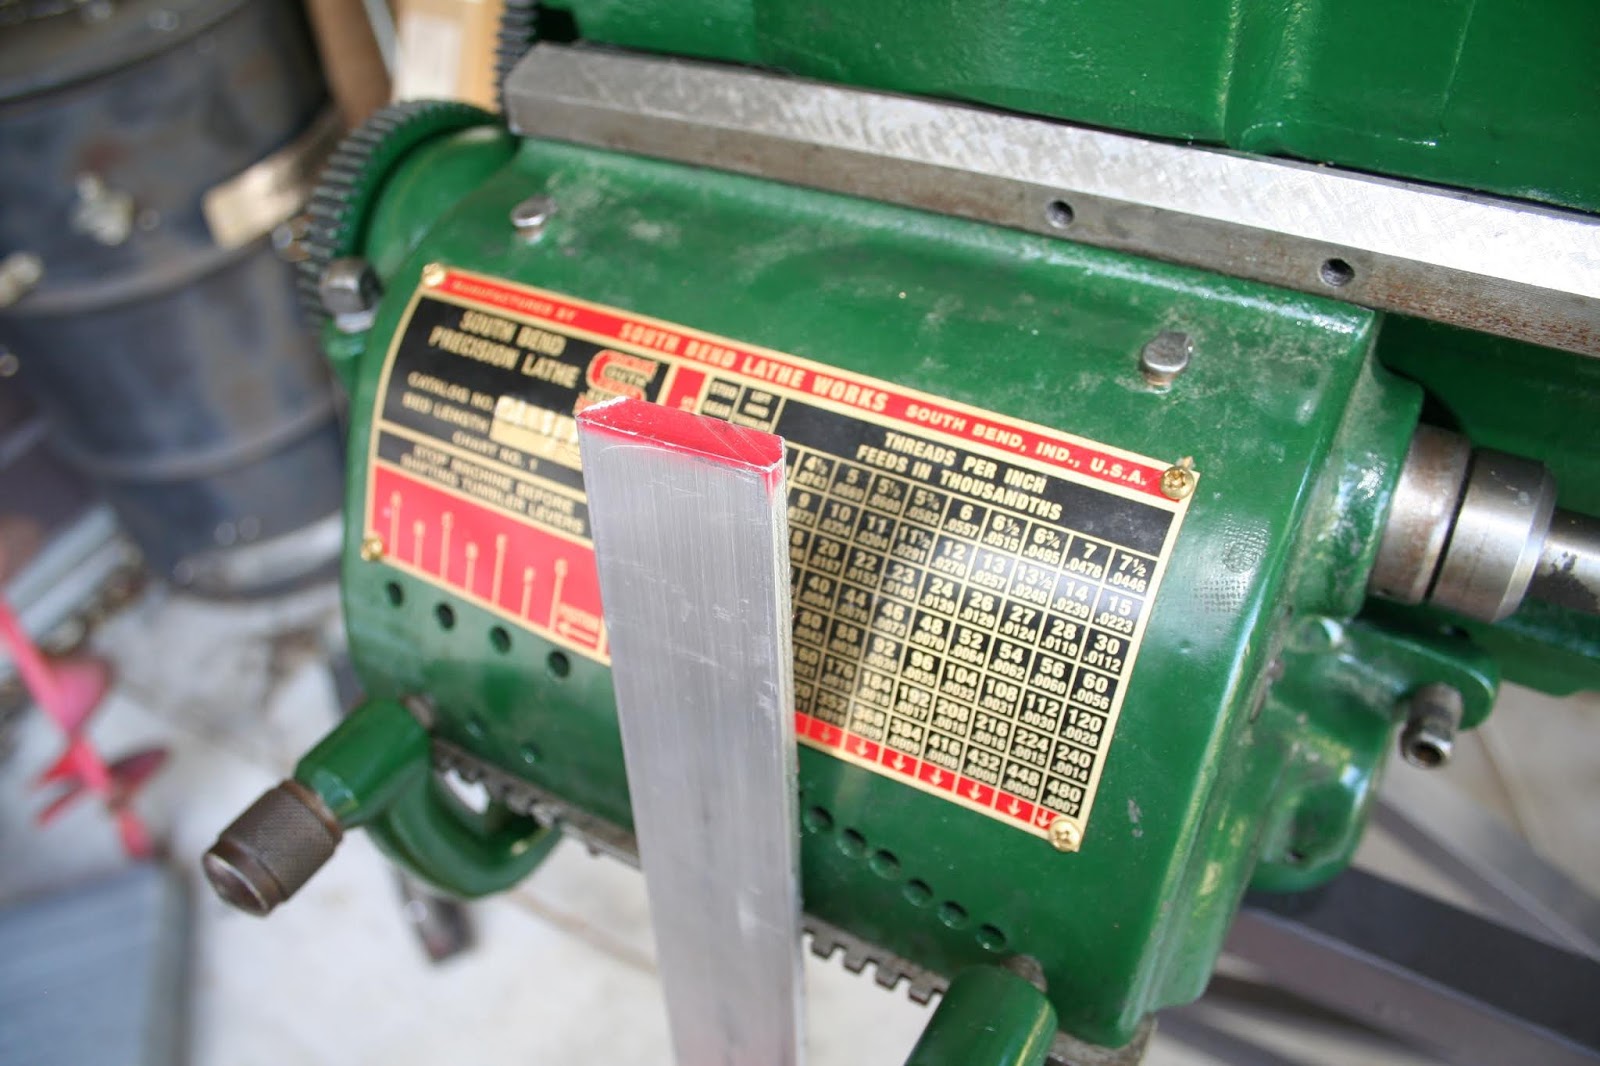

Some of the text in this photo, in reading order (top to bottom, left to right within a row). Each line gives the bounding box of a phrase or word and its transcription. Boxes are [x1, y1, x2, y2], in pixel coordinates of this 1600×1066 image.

[428, 325, 581, 389] PRECISION LATHE
[460, 310, 567, 356] SOUTH BEND
[407, 371, 471, 404] CATALOG
[433, 402, 490, 434] LENGTH
[618, 322, 681, 354] SOUTH
[684, 340, 737, 368] BEND
[741, 356, 807, 389] LATHE
[812, 375, 889, 412] WORKS
[905, 404, 967, 432] SOUTH
[972, 424, 1026, 452] BEND,
[1035, 441, 1081, 468] IND.,
[1090, 456, 1147, 486] U.S.A.
[856, 444, 1064, 521] FEEDS IN THOUSANDTHS
[884, 431, 1047, 494] THREADS PER INCH
[846, 468, 859, 484] 5
[960, 504, 973, 521] 6
[1083, 542, 1097, 559] 7
[830, 503, 851, 521] 10
[867, 515, 887, 534] 11
[943, 540, 966, 560] 12
[983, 553, 1006, 574] 13
[1065, 581, 1089, 602] 14
[1109, 595, 1133, 617] 15
[943, 518, 979, 538] .0557
[982, 530, 1020, 552] .0515
[1023, 544, 1061, 565] .0495
[1065, 558, 1103, 579] .0478
[1108, 572, 1146, 593] .0446
[817, 538, 839, 558] 20
[854, 552, 877, 570] 22
[892, 564, 915, 584] 23
[930, 578, 954, 598] 24
[969, 591, 995, 612] 26
[1009, 605, 1036, 626] 27
[1050, 619, 1077, 640] 28
[1094, 634, 1120, 655] 30
[920, 593, 955, 614] .0139
[960, 606, 995, 628] .0129
[1000, 621, 1037, 642] .0124
[1040, 635, 1078, 657] .0119
[1083, 650, 1121, 672] .0112
[971, 569, 1007, 589] .0257
[1010, 583, 1048, 604] .0248
[1052, 597, 1090, 619] .0239
[1095, 612, 1133, 634] .0223
[845, 588, 867, 607] 44
[881, 602, 905, 621] 46
[919, 615, 944, 635] 48
[958, 628, 984, 650] 52
[999, 642, 1024, 664] 54
[1040, 657, 1065, 679] 56
[1083, 672, 1108, 693] 60
[862, 670, 892, 694] 184
[900, 684, 931, 708] 192
[936, 698, 970, 723] 208
[975, 713, 1009, 738] 216
[1014, 729, 1049, 752] 224
[1056, 744, 1091, 768] 240
[873, 637, 896, 657] 92
[910, 650, 934, 672] 96
[946, 664, 978, 687] 104
[986, 678, 1019, 703] 108
[1026, 693, 1060, 717] 112
[1068, 709, 1102, 732] 120
[980, 695, 1014, 716] .0031
[1019, 710, 1056, 732] .0030
[1061, 725, 1098, 747] .0028
[989, 658, 1026, 681] .0062
[1030, 672, 1067, 695] .0060
[1072, 688, 1110, 710] .0056
[890, 717, 923, 742] 384
[928, 733, 961, 756] 416
[967, 748, 1001, 771] 432
[1006, 763, 1041, 787] 448
[1047, 780, 1081, 803] 480
[1010, 744, 1046, 766] .0015
[1052, 760, 1089, 782] .0014
